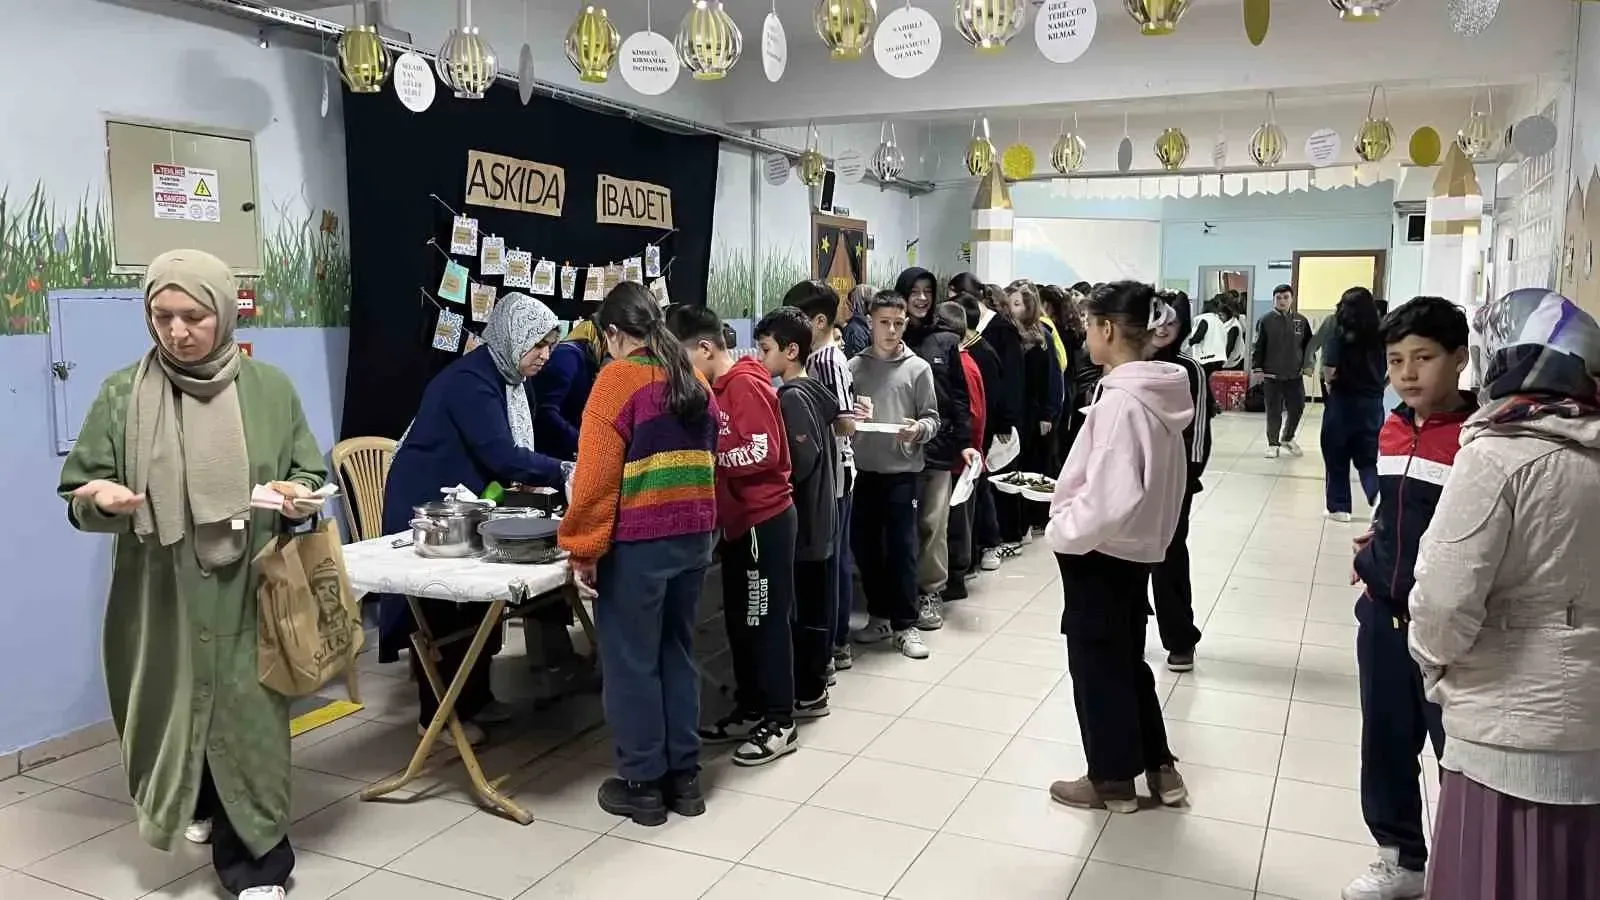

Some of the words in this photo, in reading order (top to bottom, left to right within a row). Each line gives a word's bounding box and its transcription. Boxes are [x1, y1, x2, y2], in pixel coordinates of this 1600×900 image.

[1048, 29, 1077, 41] KILMAK
[163, 194, 186, 203] DANGER
[468, 159, 561, 209] ASKIDA
[602, 175, 668, 224] İBADET
[746, 569, 760, 627] BRUINS
[760, 578, 768, 616] BOSTON
